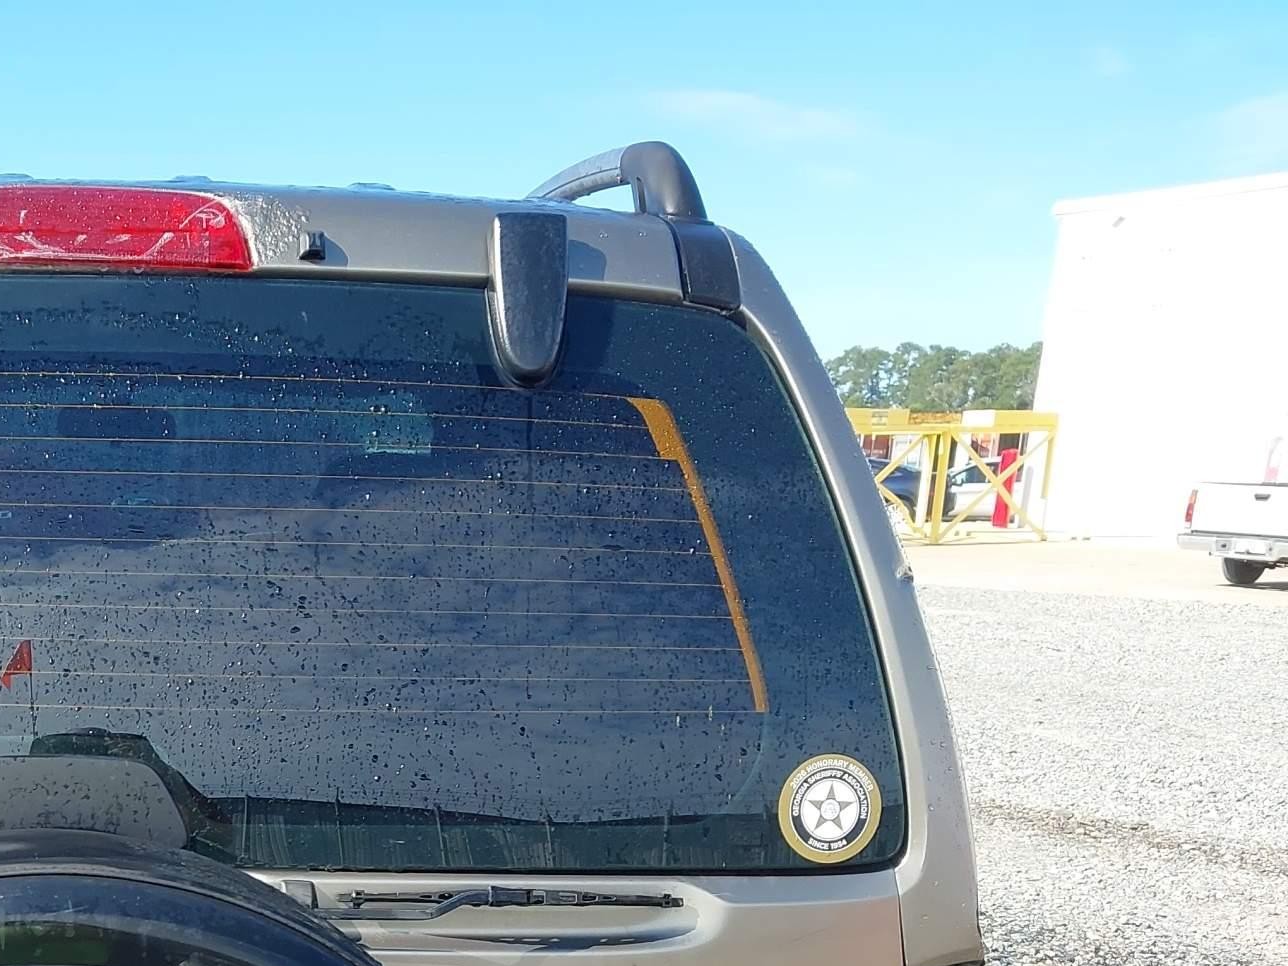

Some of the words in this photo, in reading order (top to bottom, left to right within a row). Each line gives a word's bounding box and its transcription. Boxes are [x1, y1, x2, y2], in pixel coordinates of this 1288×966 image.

[790, 769, 807, 790] 2026
[806, 758, 850, 773] HONORARY
[847, 761, 874, 792] MEMBER
[792, 781, 810, 817] GEORGIA
[842, 773, 868, 819] ASSOCIATION
[807, 836, 829, 850] SINCE
